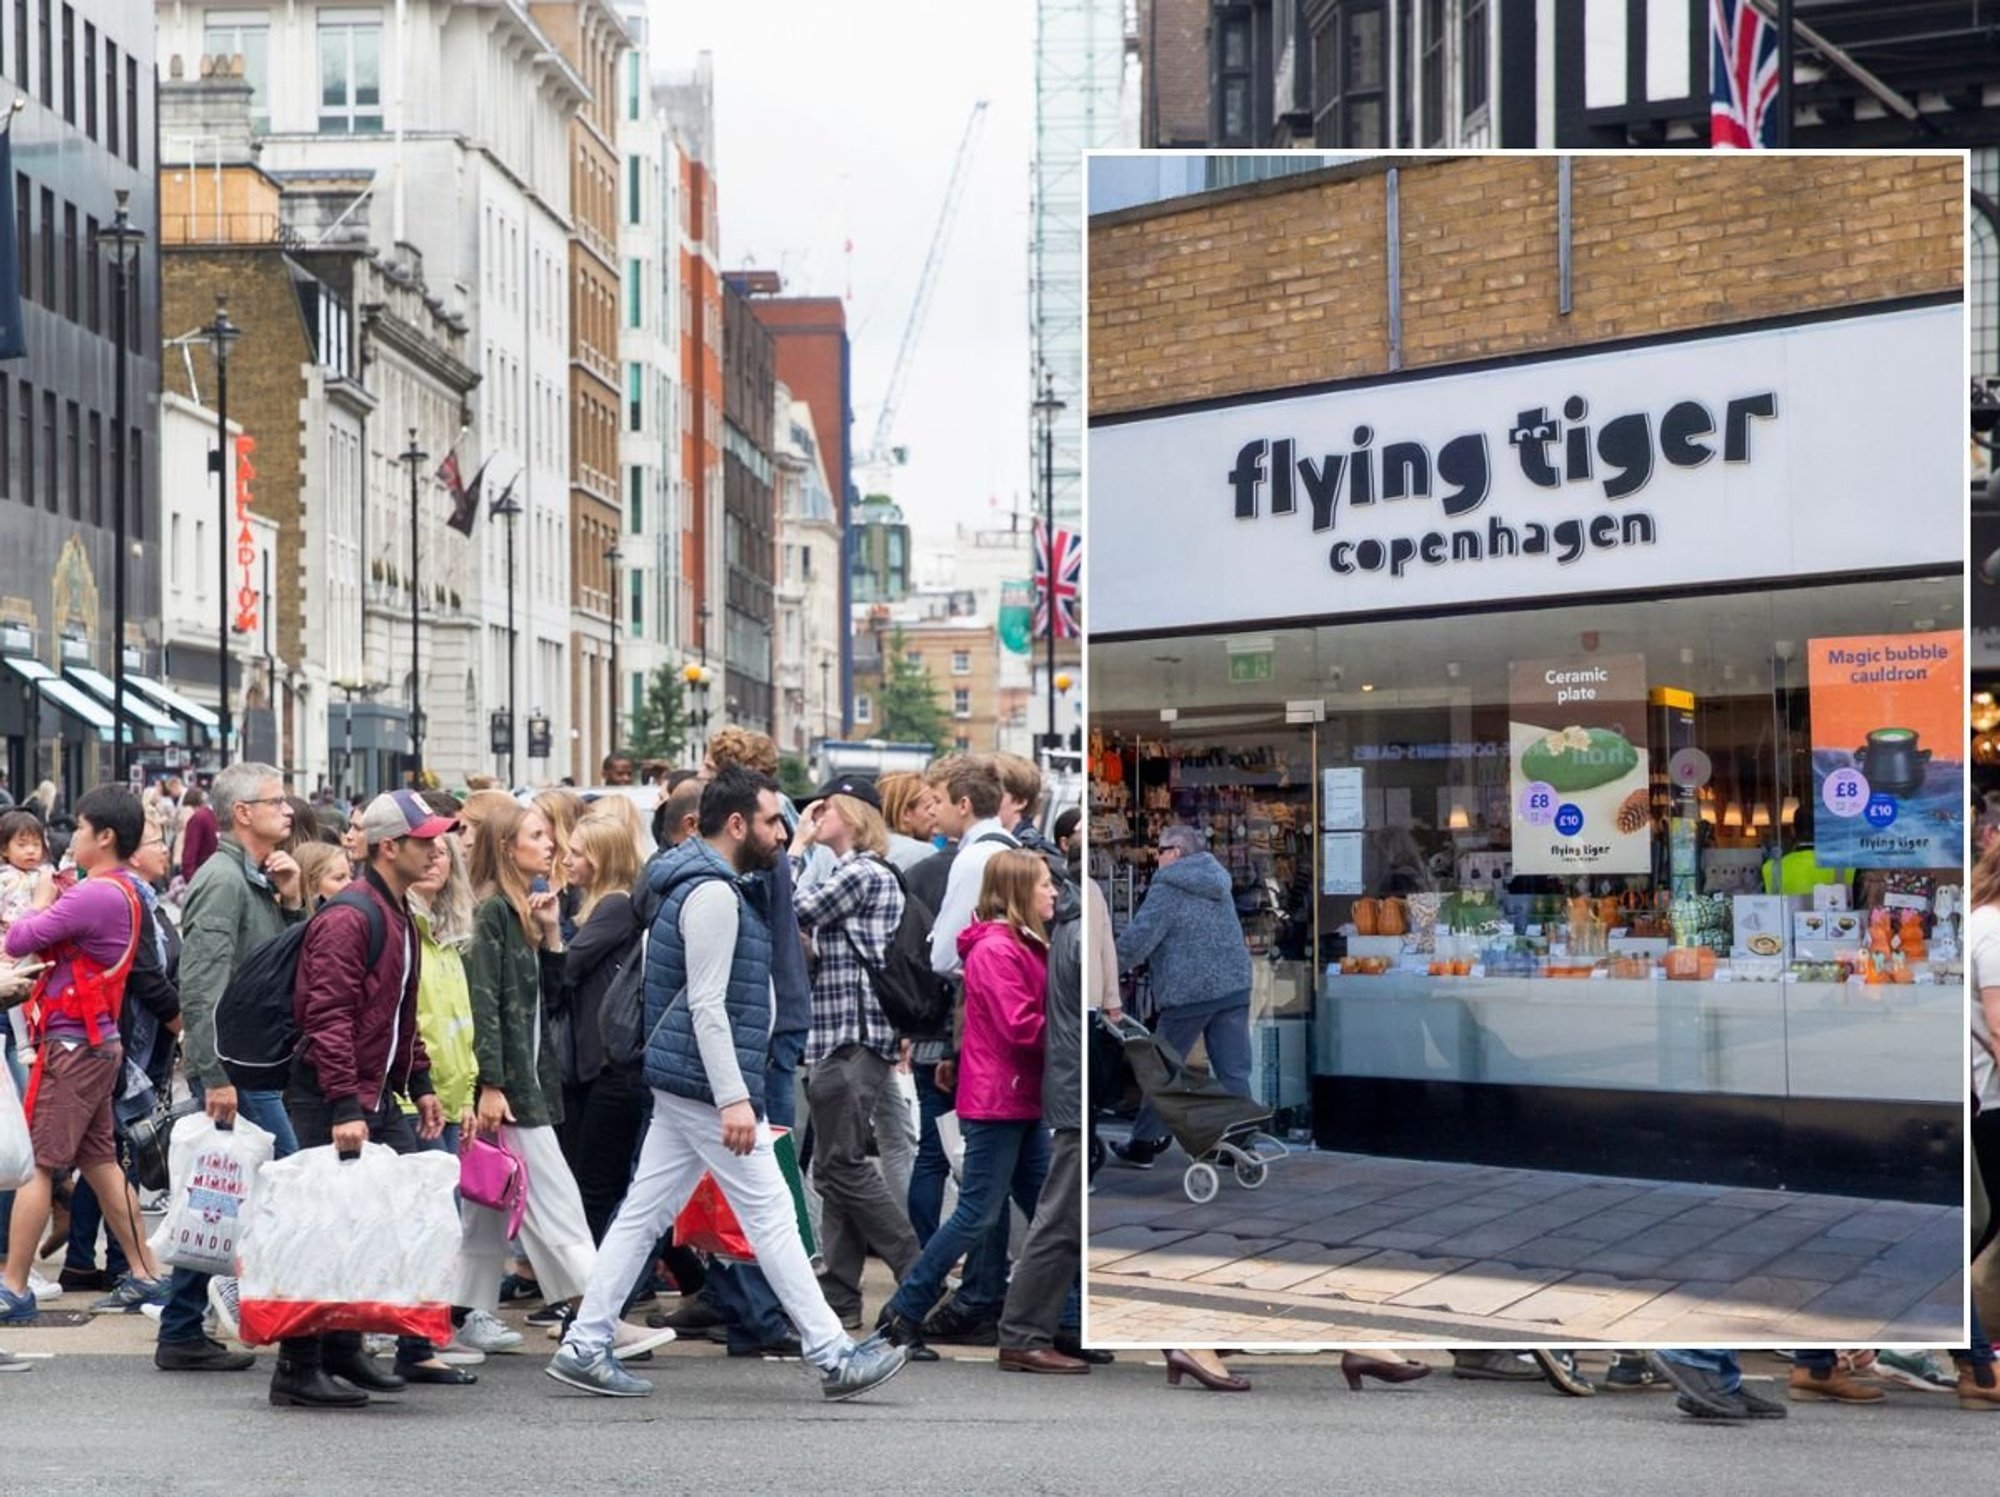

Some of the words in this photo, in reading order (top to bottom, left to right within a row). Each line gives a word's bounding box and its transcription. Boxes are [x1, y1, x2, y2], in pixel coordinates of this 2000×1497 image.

[1228, 425, 1492, 532] flying
[1508, 392, 1778, 500] tiger
[1328, 511, 1656, 577] copenhagen
[1828, 648, 1881, 667] Magic
[1885, 644, 1948, 661] bubble
[1545, 667, 1608, 684] Ceramic
[1850, 666, 1927, 683] cauldron
[1557, 686, 1596, 705] plate
[1836, 781, 1858, 797] £8
[1530, 794, 1549, 808] £8
[1870, 805, 1892, 816] £10
[1559, 815, 1579, 826] £10
[1551, 845, 1581, 857] flying
[1583, 844, 1611, 856] tiger
[170, 1228, 232, 1252] LONDO
